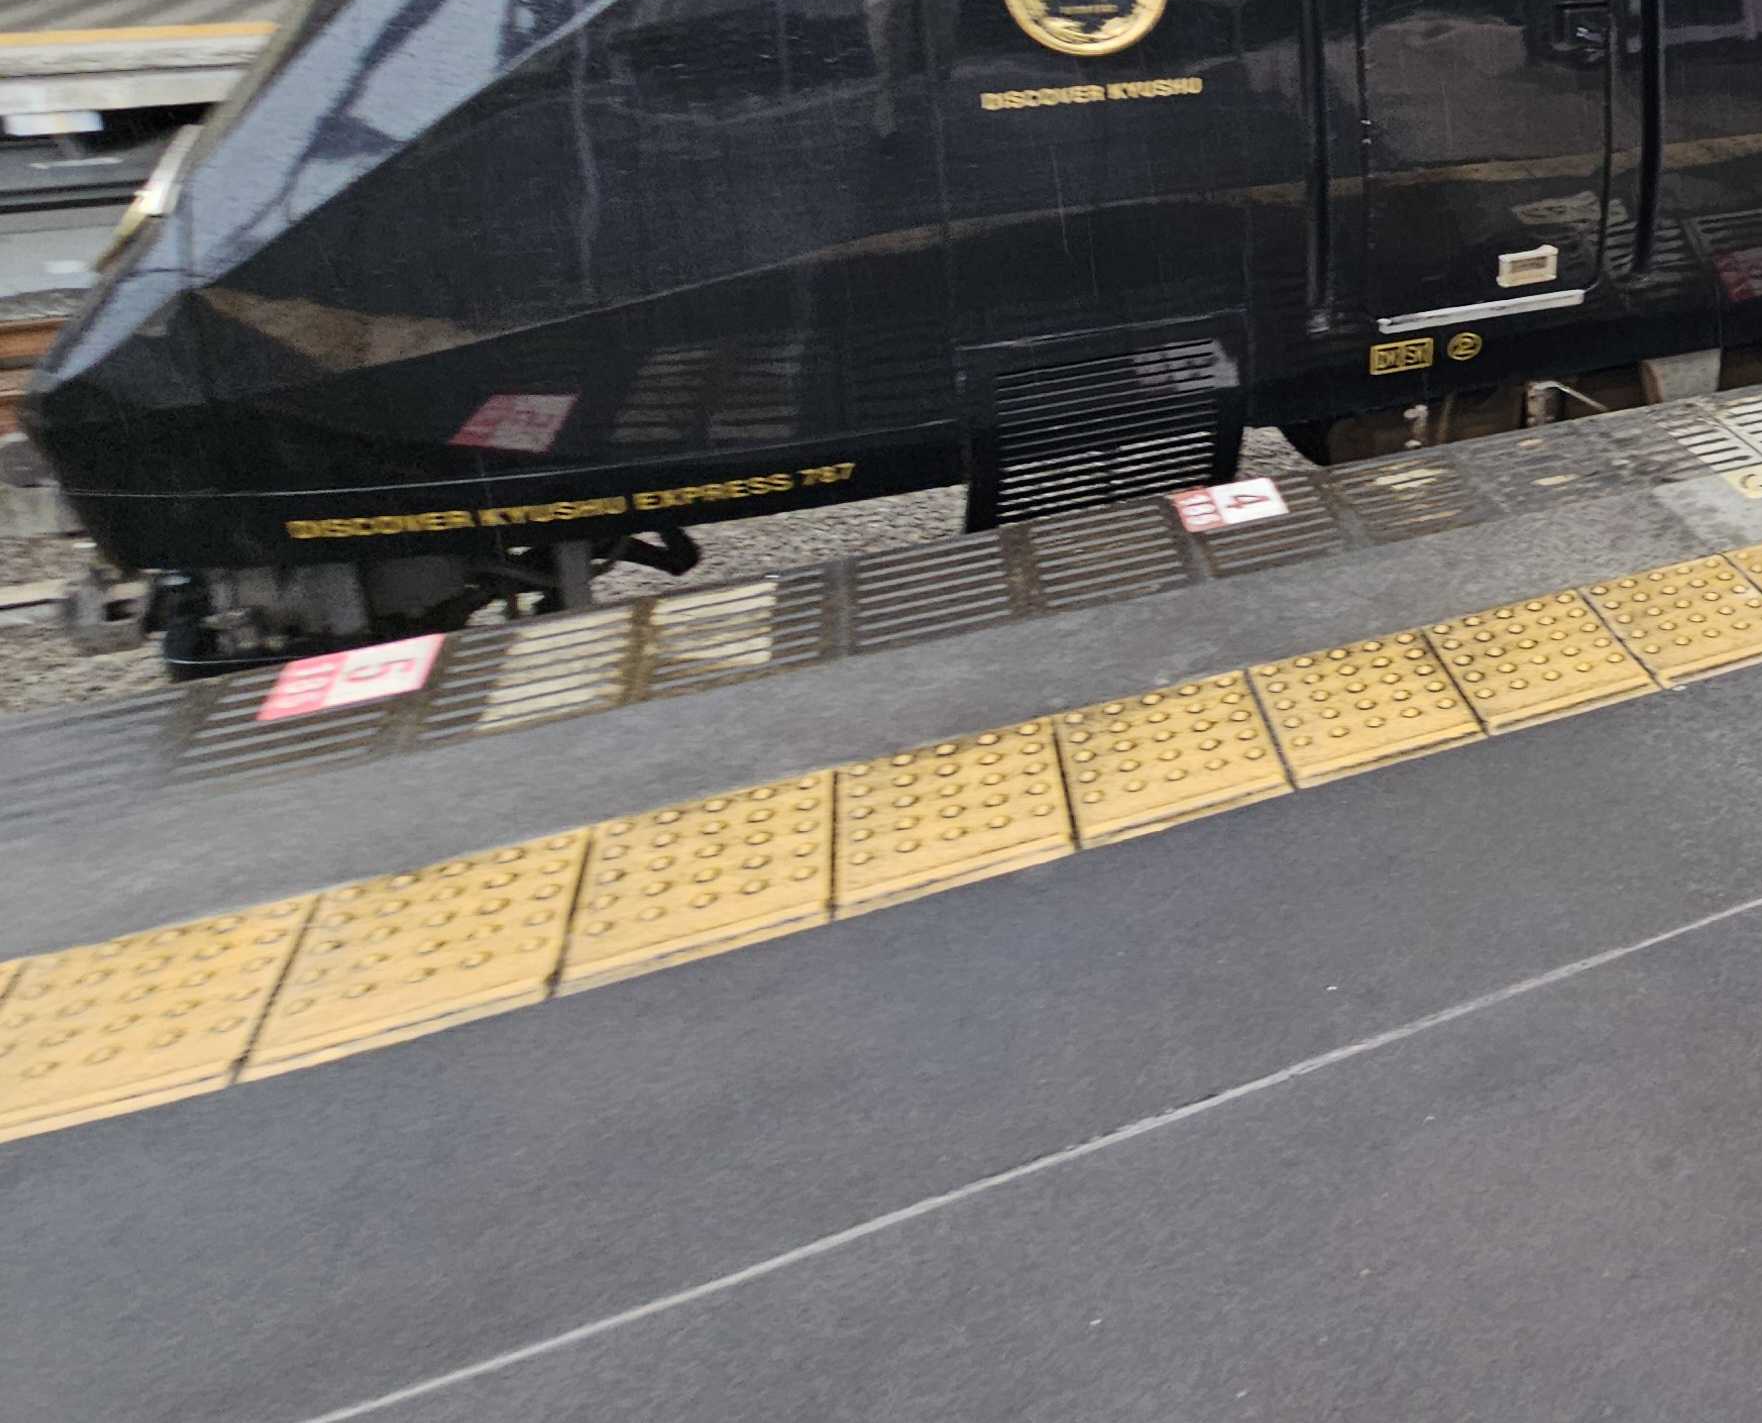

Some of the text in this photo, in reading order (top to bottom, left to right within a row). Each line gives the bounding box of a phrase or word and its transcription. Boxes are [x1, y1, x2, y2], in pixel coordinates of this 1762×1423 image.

[980, 77, 1204, 111] DISCOVER KYUSHU
[286, 462, 856, 539] DISCOVER KYUSHU EXPRESS 787
[1225, 494, 1270, 510] 4
[345, 657, 416, 683] 5
